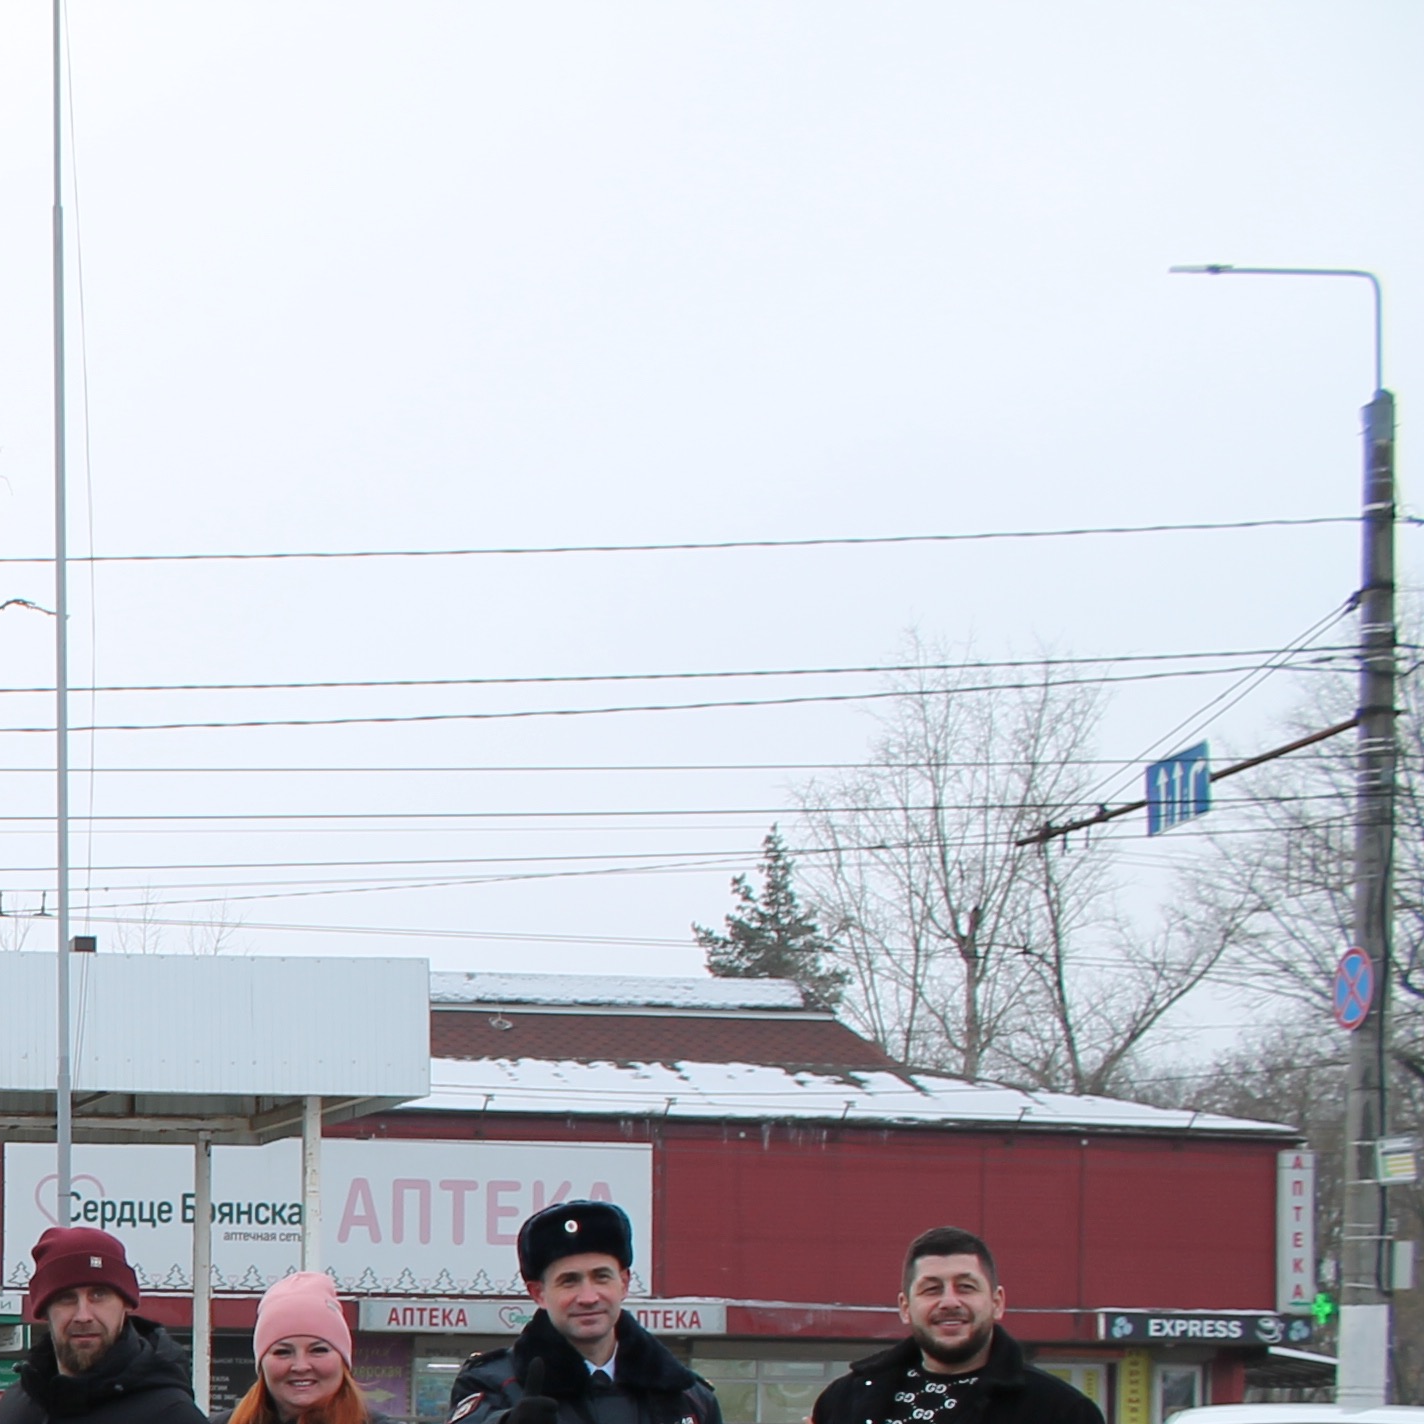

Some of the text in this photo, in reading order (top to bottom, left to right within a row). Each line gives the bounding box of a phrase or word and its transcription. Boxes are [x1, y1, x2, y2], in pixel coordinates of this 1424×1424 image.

[69, 1191, 173, 1228] Сердце
[223, 1231, 277, 1242] аптечная
[1292, 1155, 1305, 1298] АПТЕКА
[387, 1307, 468, 1327] АПТЕКА
[637, 1309, 702, 1330] ПТЕКА
[1148, 1318, 1243, 1338] EXPRESS
